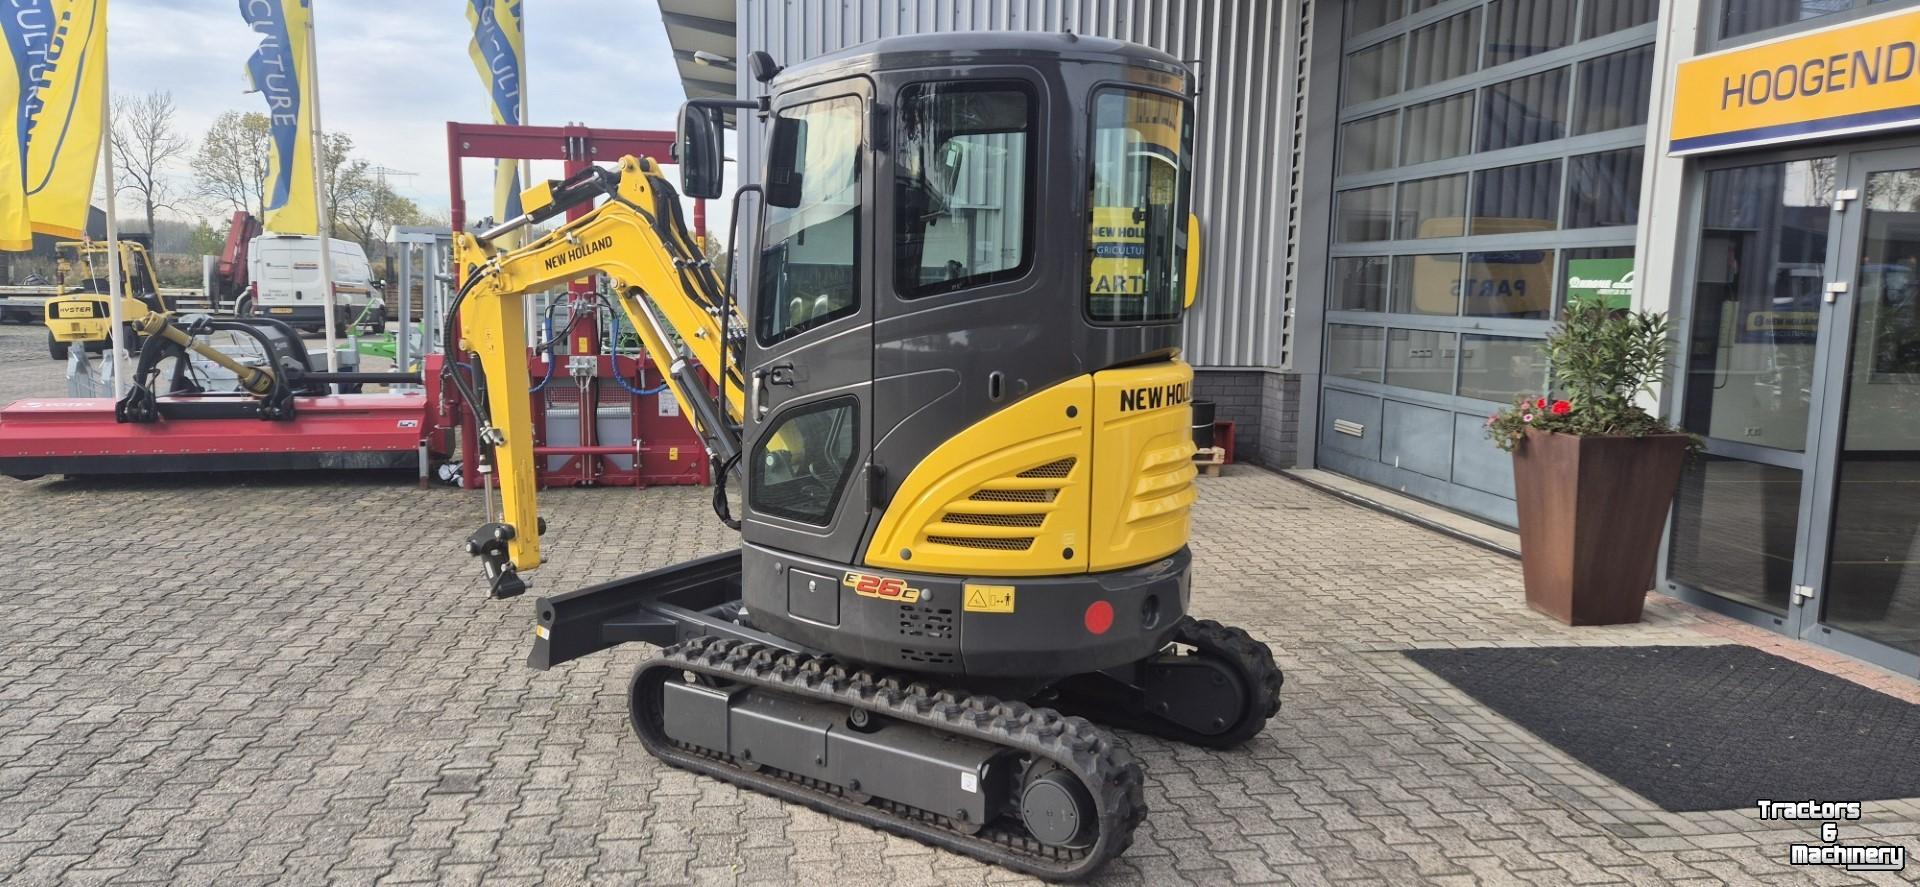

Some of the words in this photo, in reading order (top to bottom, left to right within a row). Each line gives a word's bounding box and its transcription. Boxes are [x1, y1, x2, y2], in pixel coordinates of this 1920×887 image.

[1721, 41, 1920, 111] HOOGEND
[545, 252, 566, 270] NEW
[568, 235, 613, 261] HOLLAND
[1120, 386, 1163, 412] NEW
